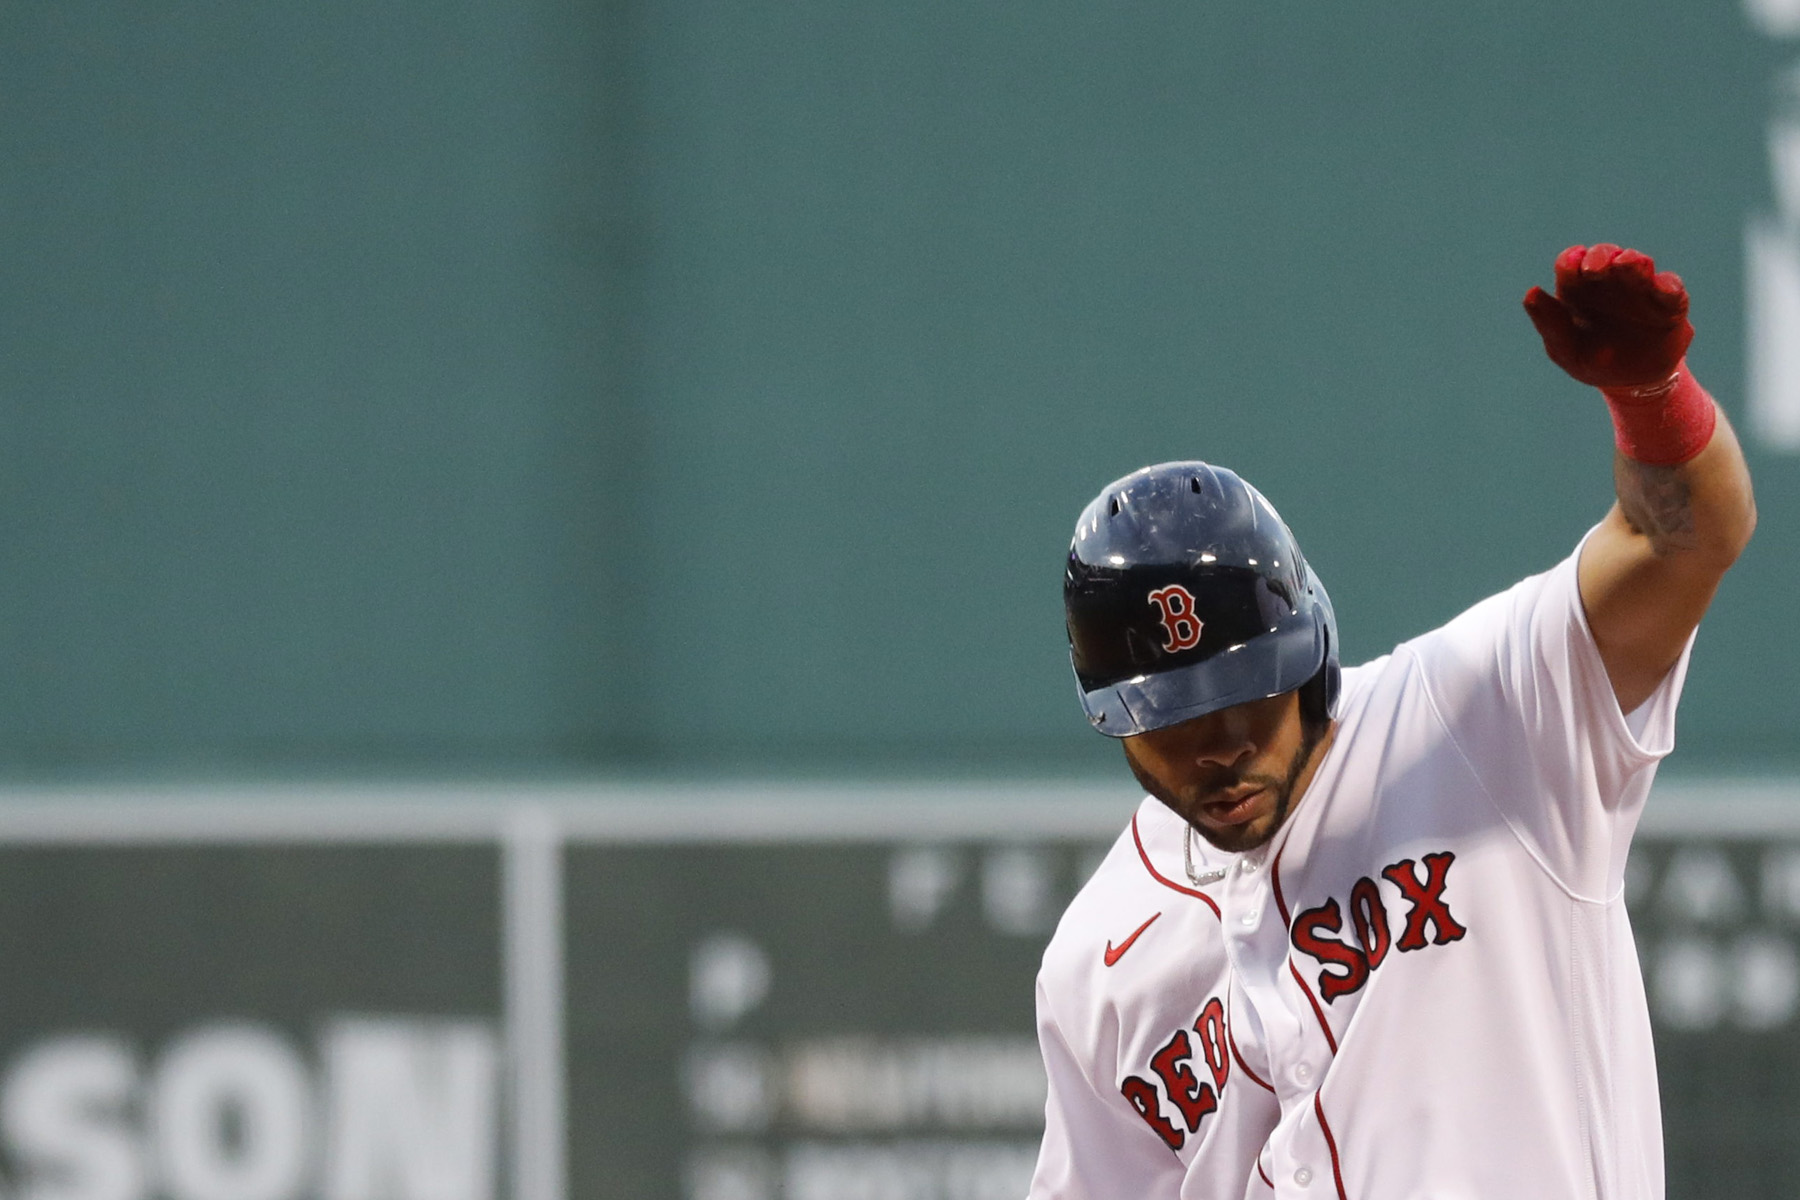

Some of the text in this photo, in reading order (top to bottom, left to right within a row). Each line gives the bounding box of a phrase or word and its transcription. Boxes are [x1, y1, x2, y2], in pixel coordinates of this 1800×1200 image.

[1148, 584, 1204, 653] B
[1121, 996, 1230, 1150] RED
[1291, 850, 1468, 1006] SOX
